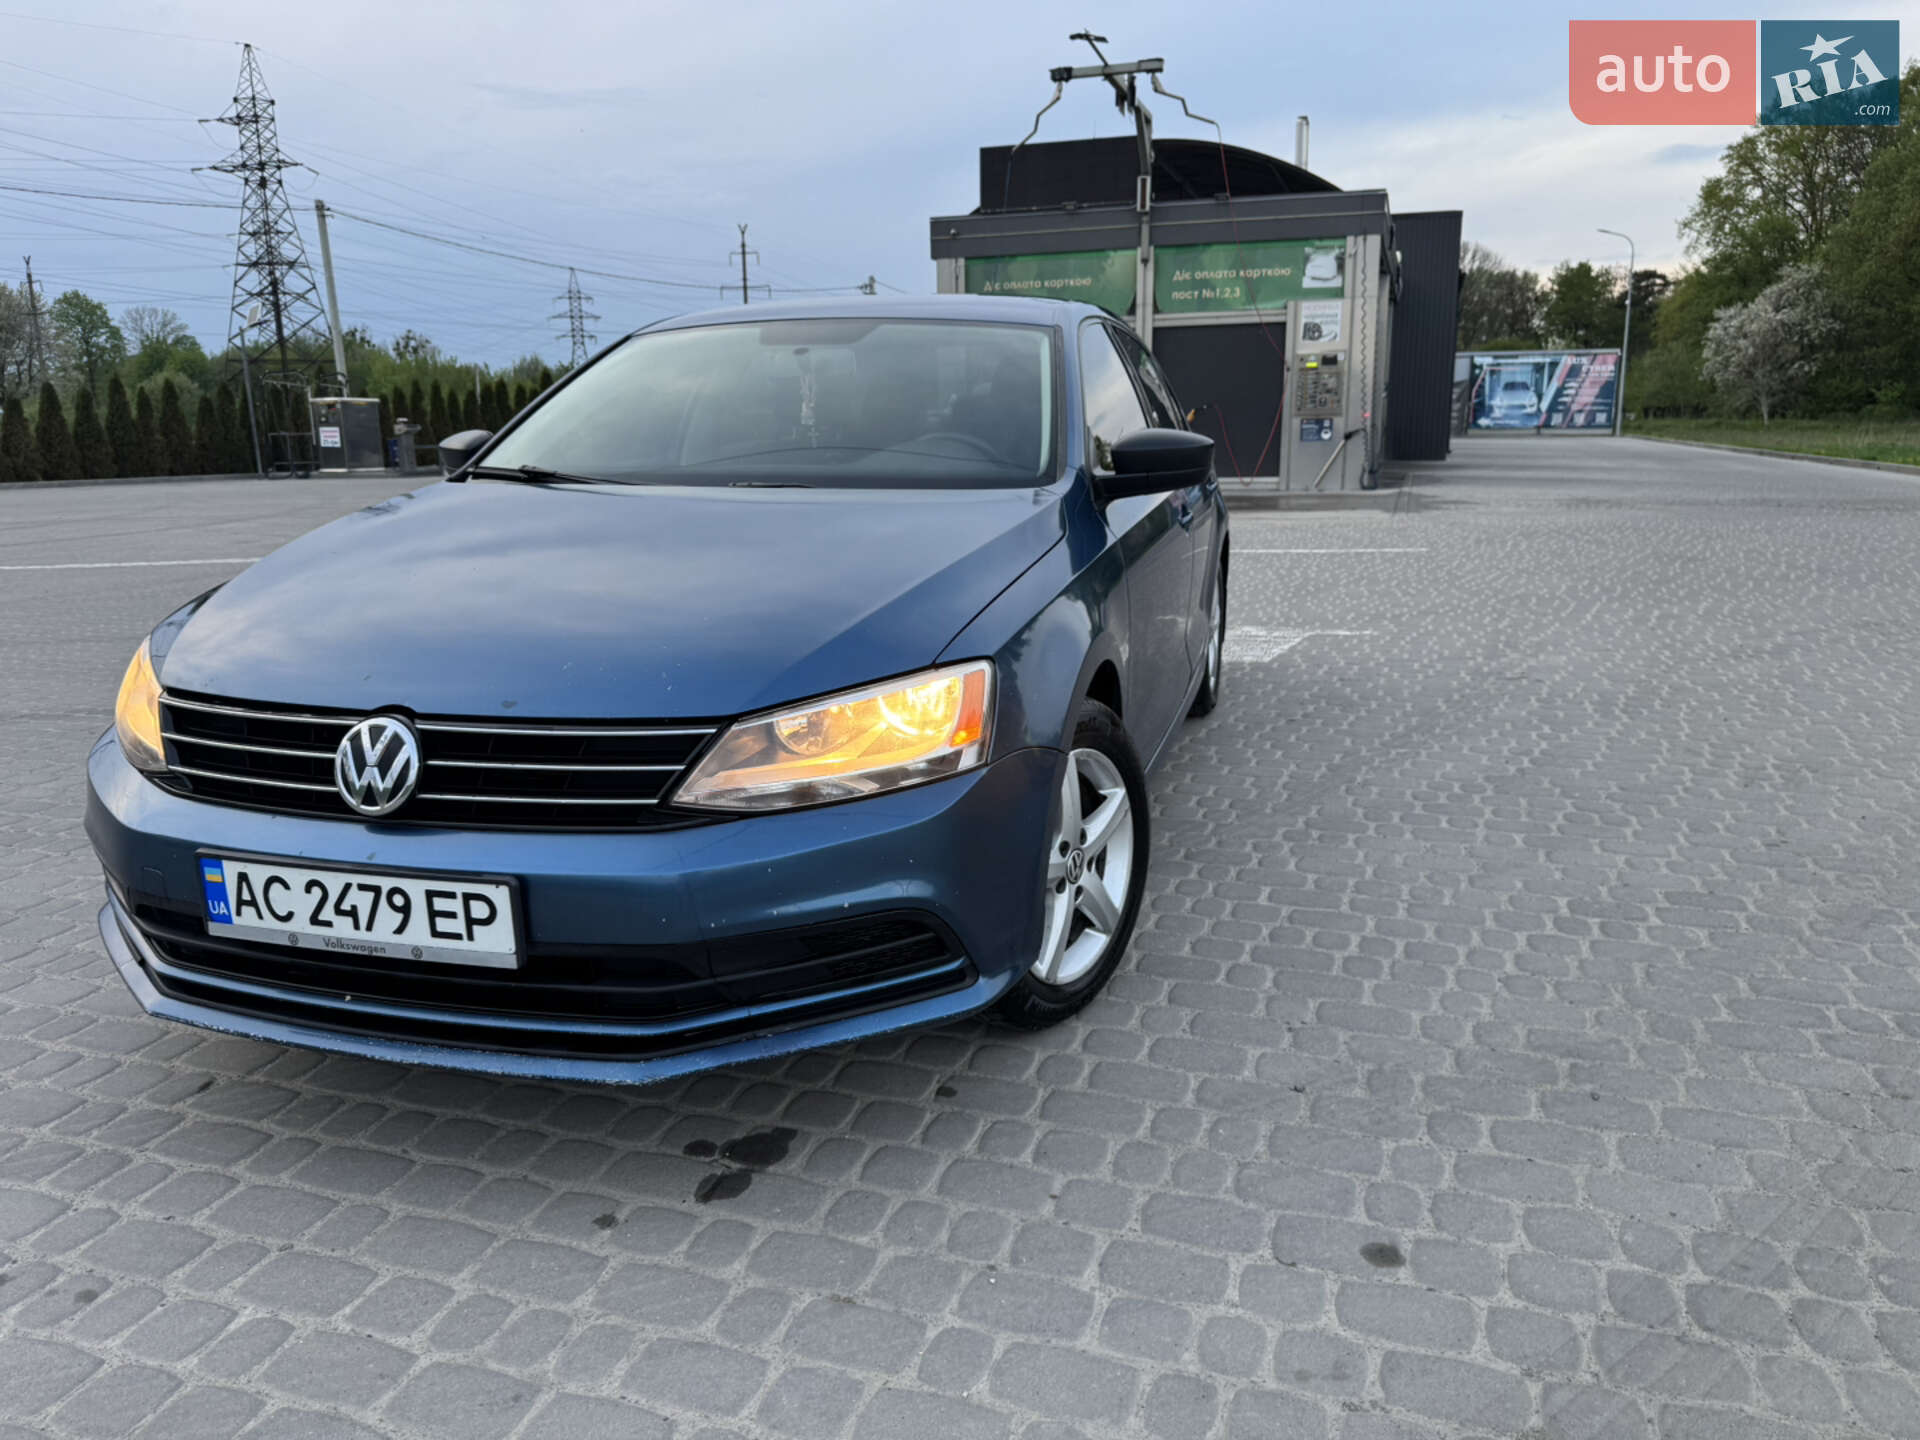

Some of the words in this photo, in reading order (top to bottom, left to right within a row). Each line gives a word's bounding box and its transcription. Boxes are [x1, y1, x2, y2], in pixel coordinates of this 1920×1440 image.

[1194, 269, 1237, 280] оплата
[1239, 267, 1291, 279] карткою
[1171, 290, 1199, 300] пост
[208, 899, 230, 916] UA
[235, 871, 295, 923] AC
[304, 878, 412, 935] 2479
[424, 888, 498, 942] EP
[322, 937, 387, 957] Volkswagen
